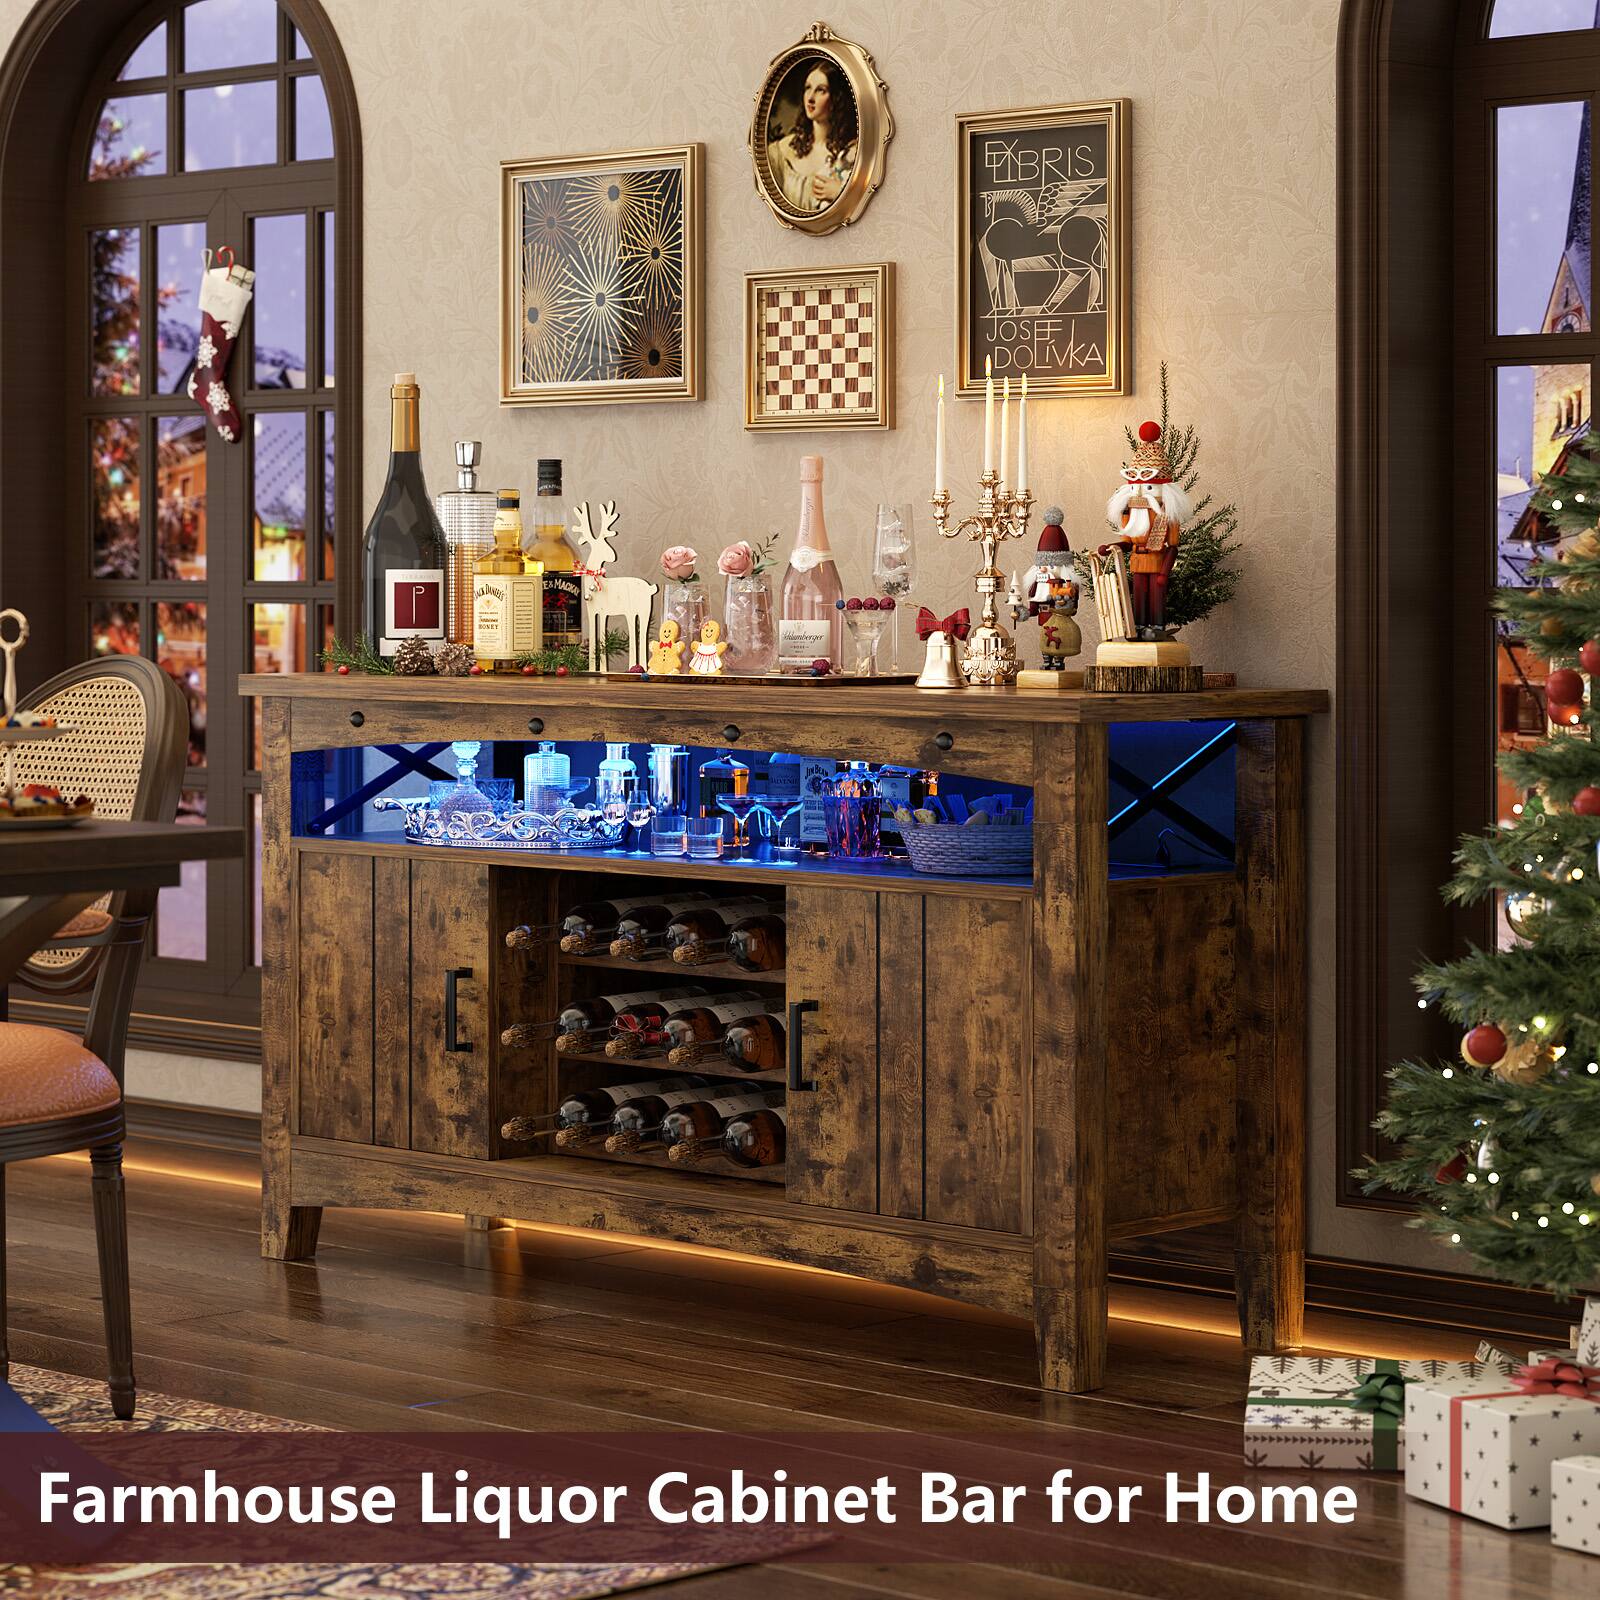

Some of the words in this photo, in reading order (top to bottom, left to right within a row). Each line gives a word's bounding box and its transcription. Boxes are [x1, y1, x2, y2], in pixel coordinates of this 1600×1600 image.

[986, 320, 1063, 342] JOSEF
[412, 585, 425, 625] P
[804, 766, 815, 779] JIM
[815, 764, 829, 777] BEAM
